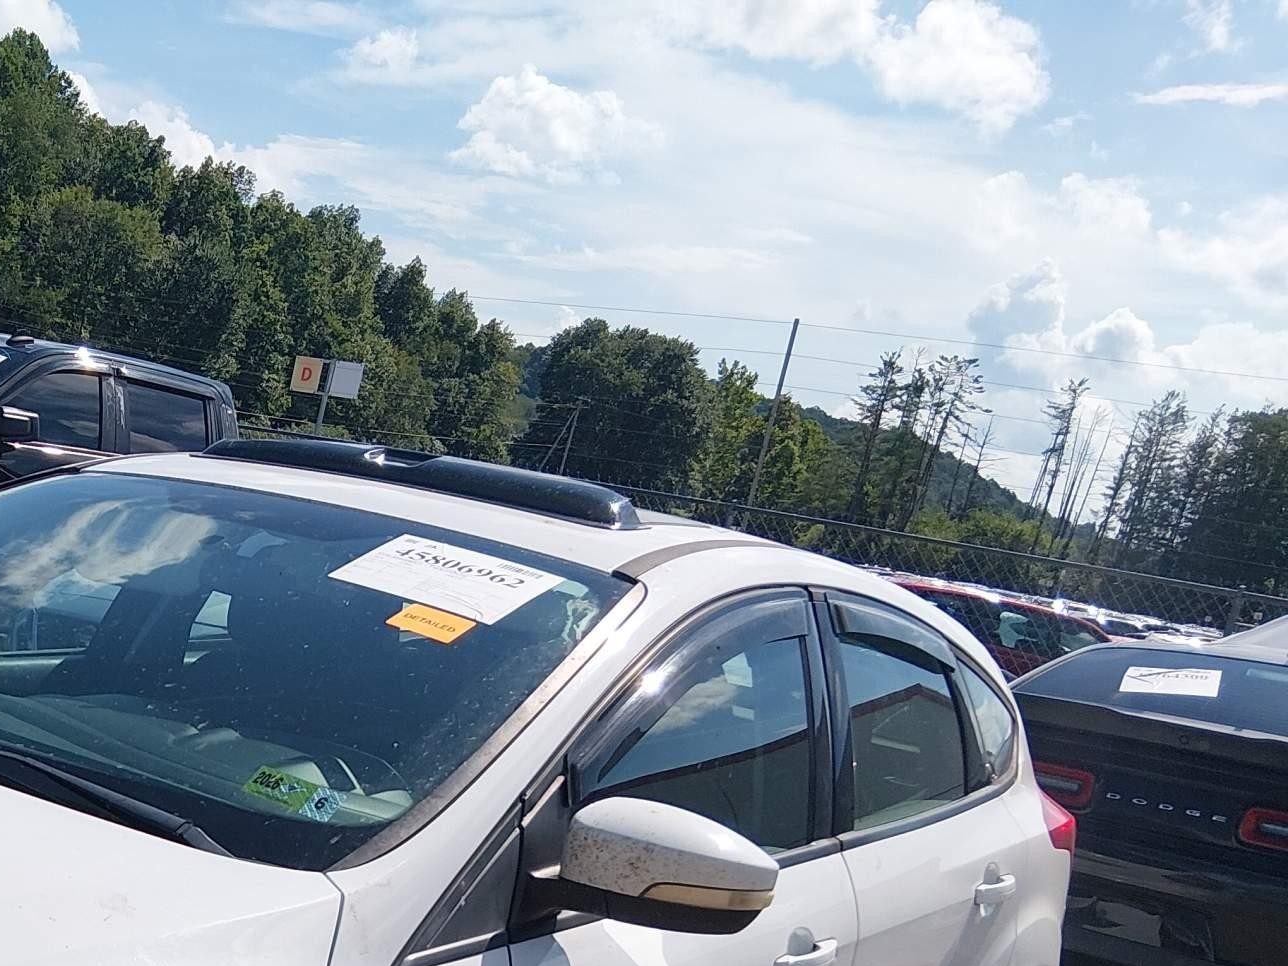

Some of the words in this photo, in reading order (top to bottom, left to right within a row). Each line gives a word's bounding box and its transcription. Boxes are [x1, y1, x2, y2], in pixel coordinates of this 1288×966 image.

[301, 367, 313, 382] D
[395, 547, 526, 589] 45806962
[403, 612, 457, 634] DETAILED
[252, 770, 284, 790] 2026
[314, 797, 329, 810] 6
[1106, 792, 1227, 822] DODGE
